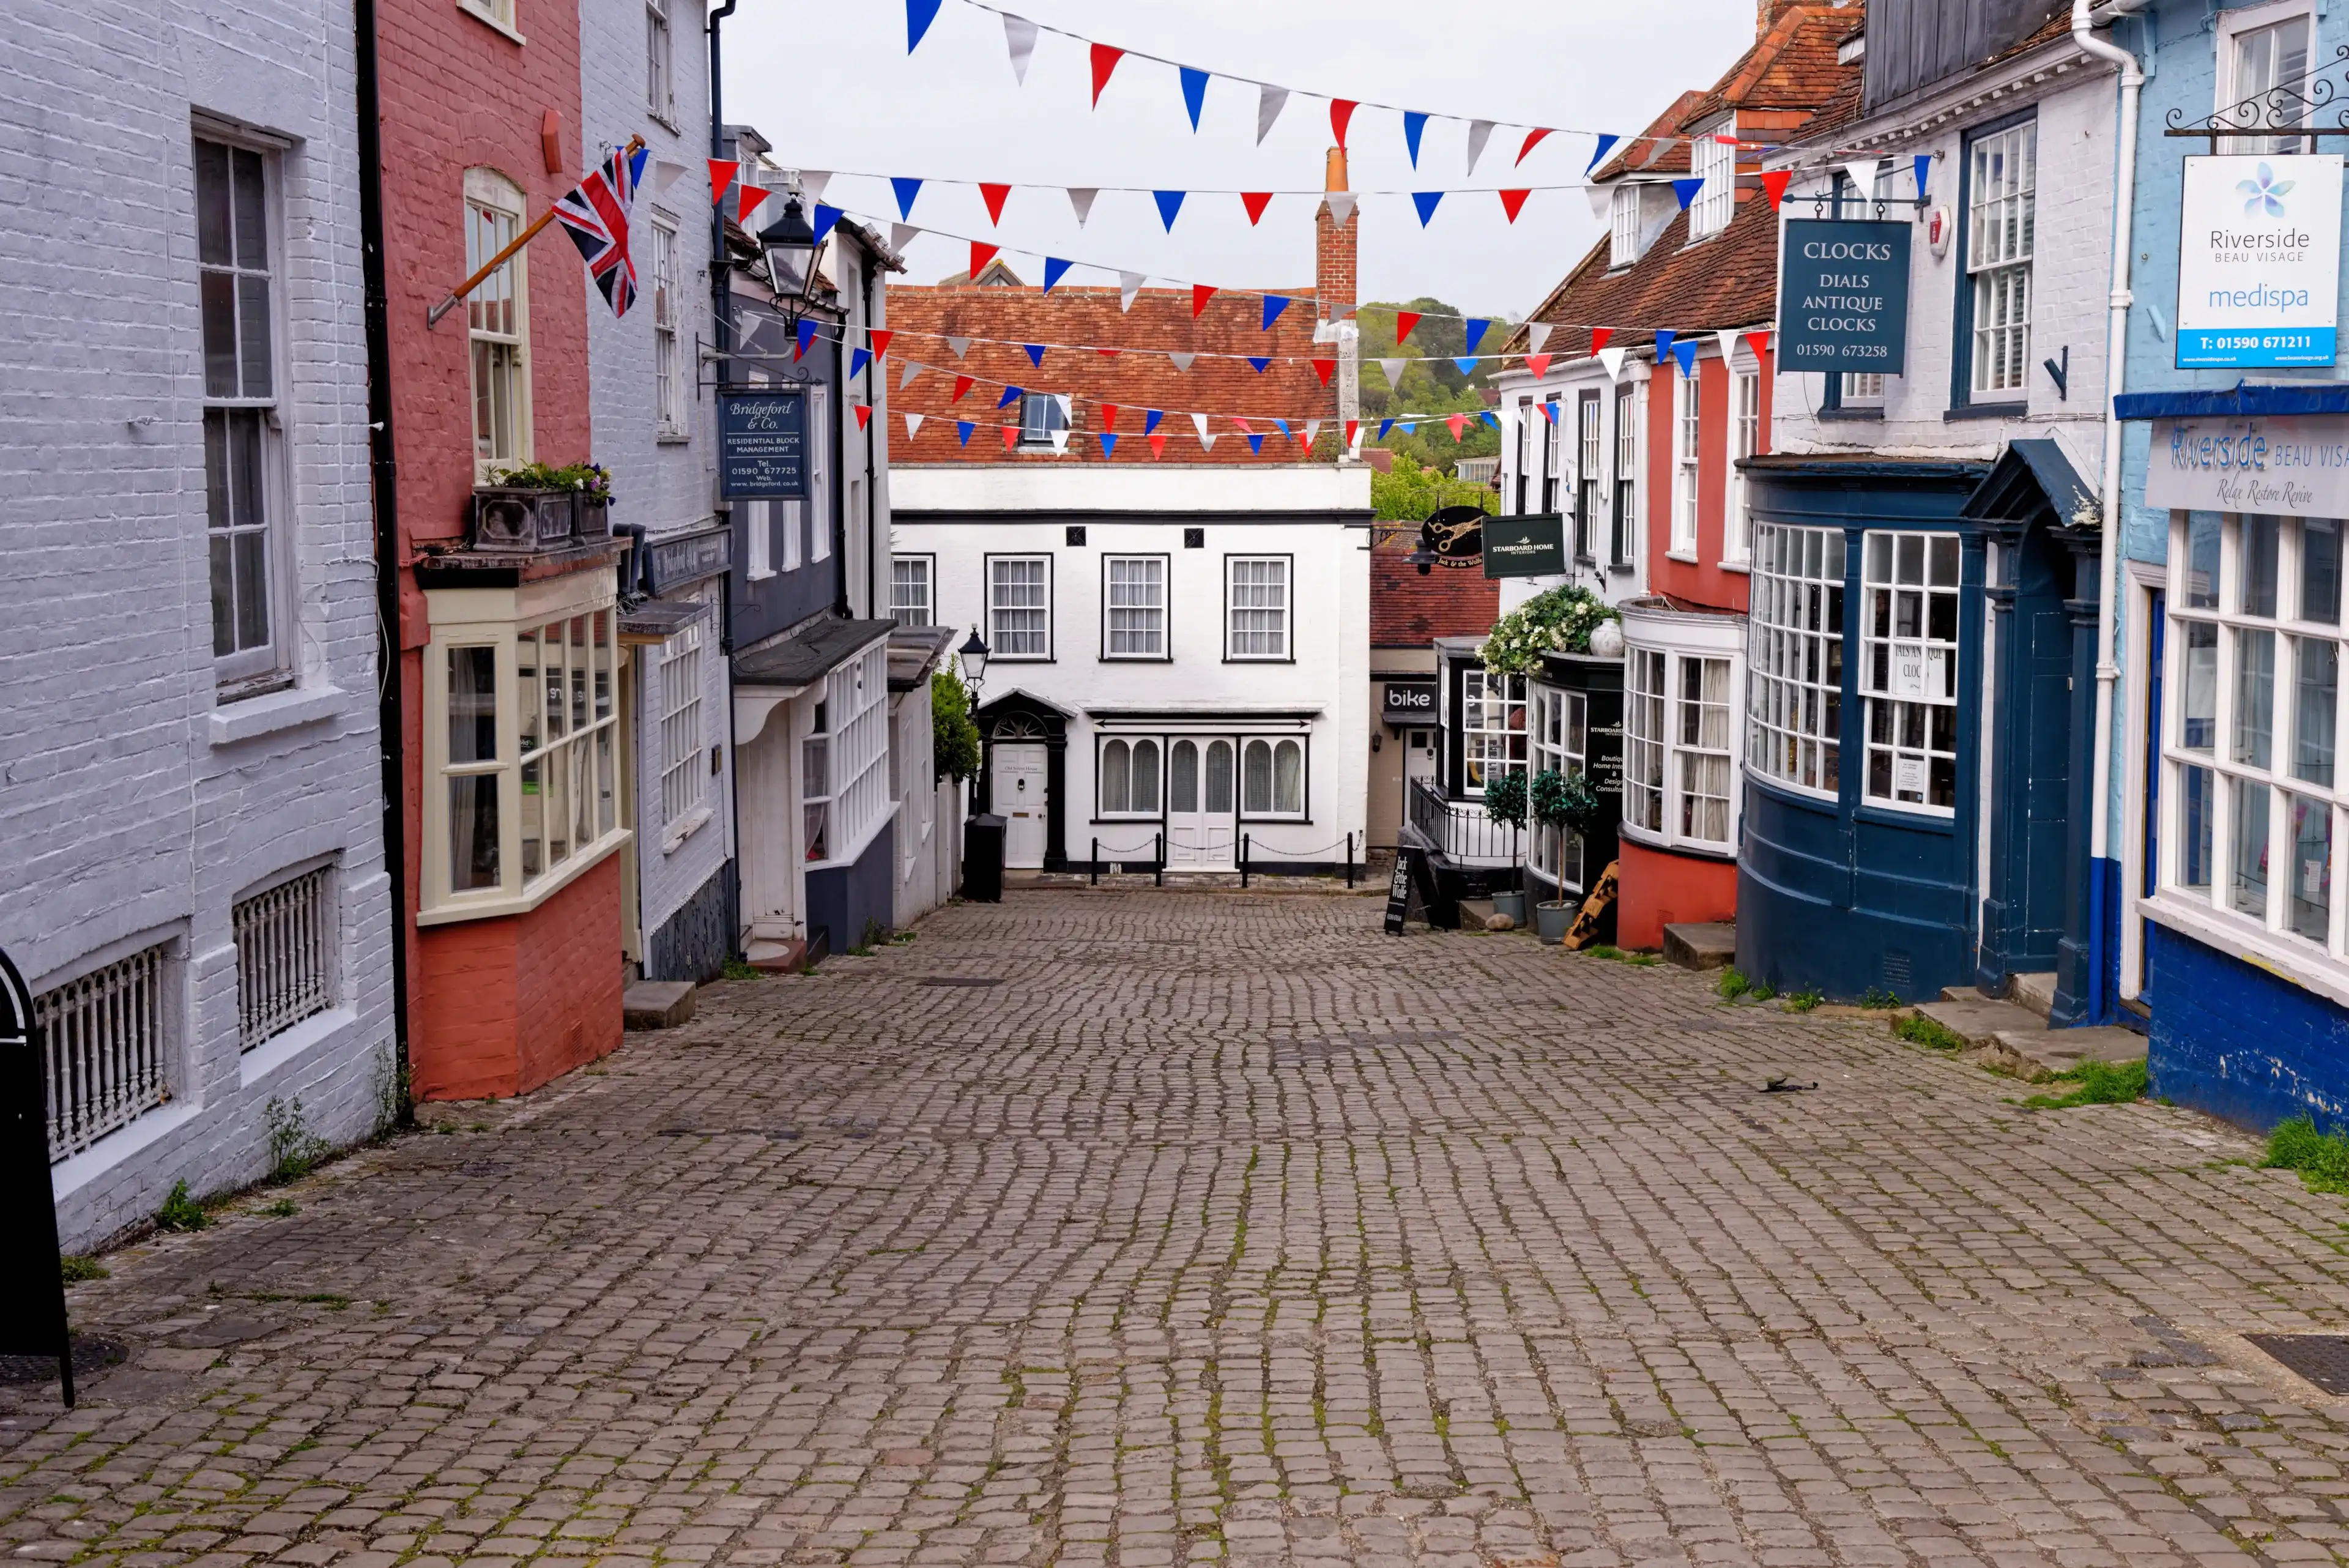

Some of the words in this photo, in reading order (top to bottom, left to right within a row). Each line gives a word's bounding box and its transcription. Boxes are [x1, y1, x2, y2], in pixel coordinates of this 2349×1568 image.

[2210, 228, 2310, 249] Riverside
[1803, 242, 1891, 260] CLOCKS
[2214, 253, 2249, 263] BEAU
[2257, 251, 2304, 262] VISAGE
[1819, 274, 1869, 288] DIALS
[1802, 295, 1883, 313] ANTIQUE
[2209, 283, 2309, 313] medispa
[1808, 318, 1876, 332] CLOCKS
[1797, 344, 1835, 356] 01590
[1842, 345, 1887, 357] 673258
[2200, 337, 2213, 349] T:
[2216, 336, 2259, 349] 01590
[2263, 336, 2311, 349] 671211
[730, 401, 795, 419] Bridgeford
[748, 418, 758, 429] &
[761, 417, 778, 429] Co.
[2172, 422, 2267, 468] Riverside
[2274, 445, 2312, 467] BEAU
[2217, 470, 2243, 509] Relax
[2247, 479, 2280, 506] Restore
[2282, 481, 2314, 509] Revive
[1468, 557, 1483, 566] Wolfe
[1896, 645, 1910, 657] IALS
[1912, 645, 1942, 661] ANQUE
[1389, 689, 1430, 707] bike
[1395, 856, 1408, 872] Jack
[1392, 884, 1407, 899] Wolfe
